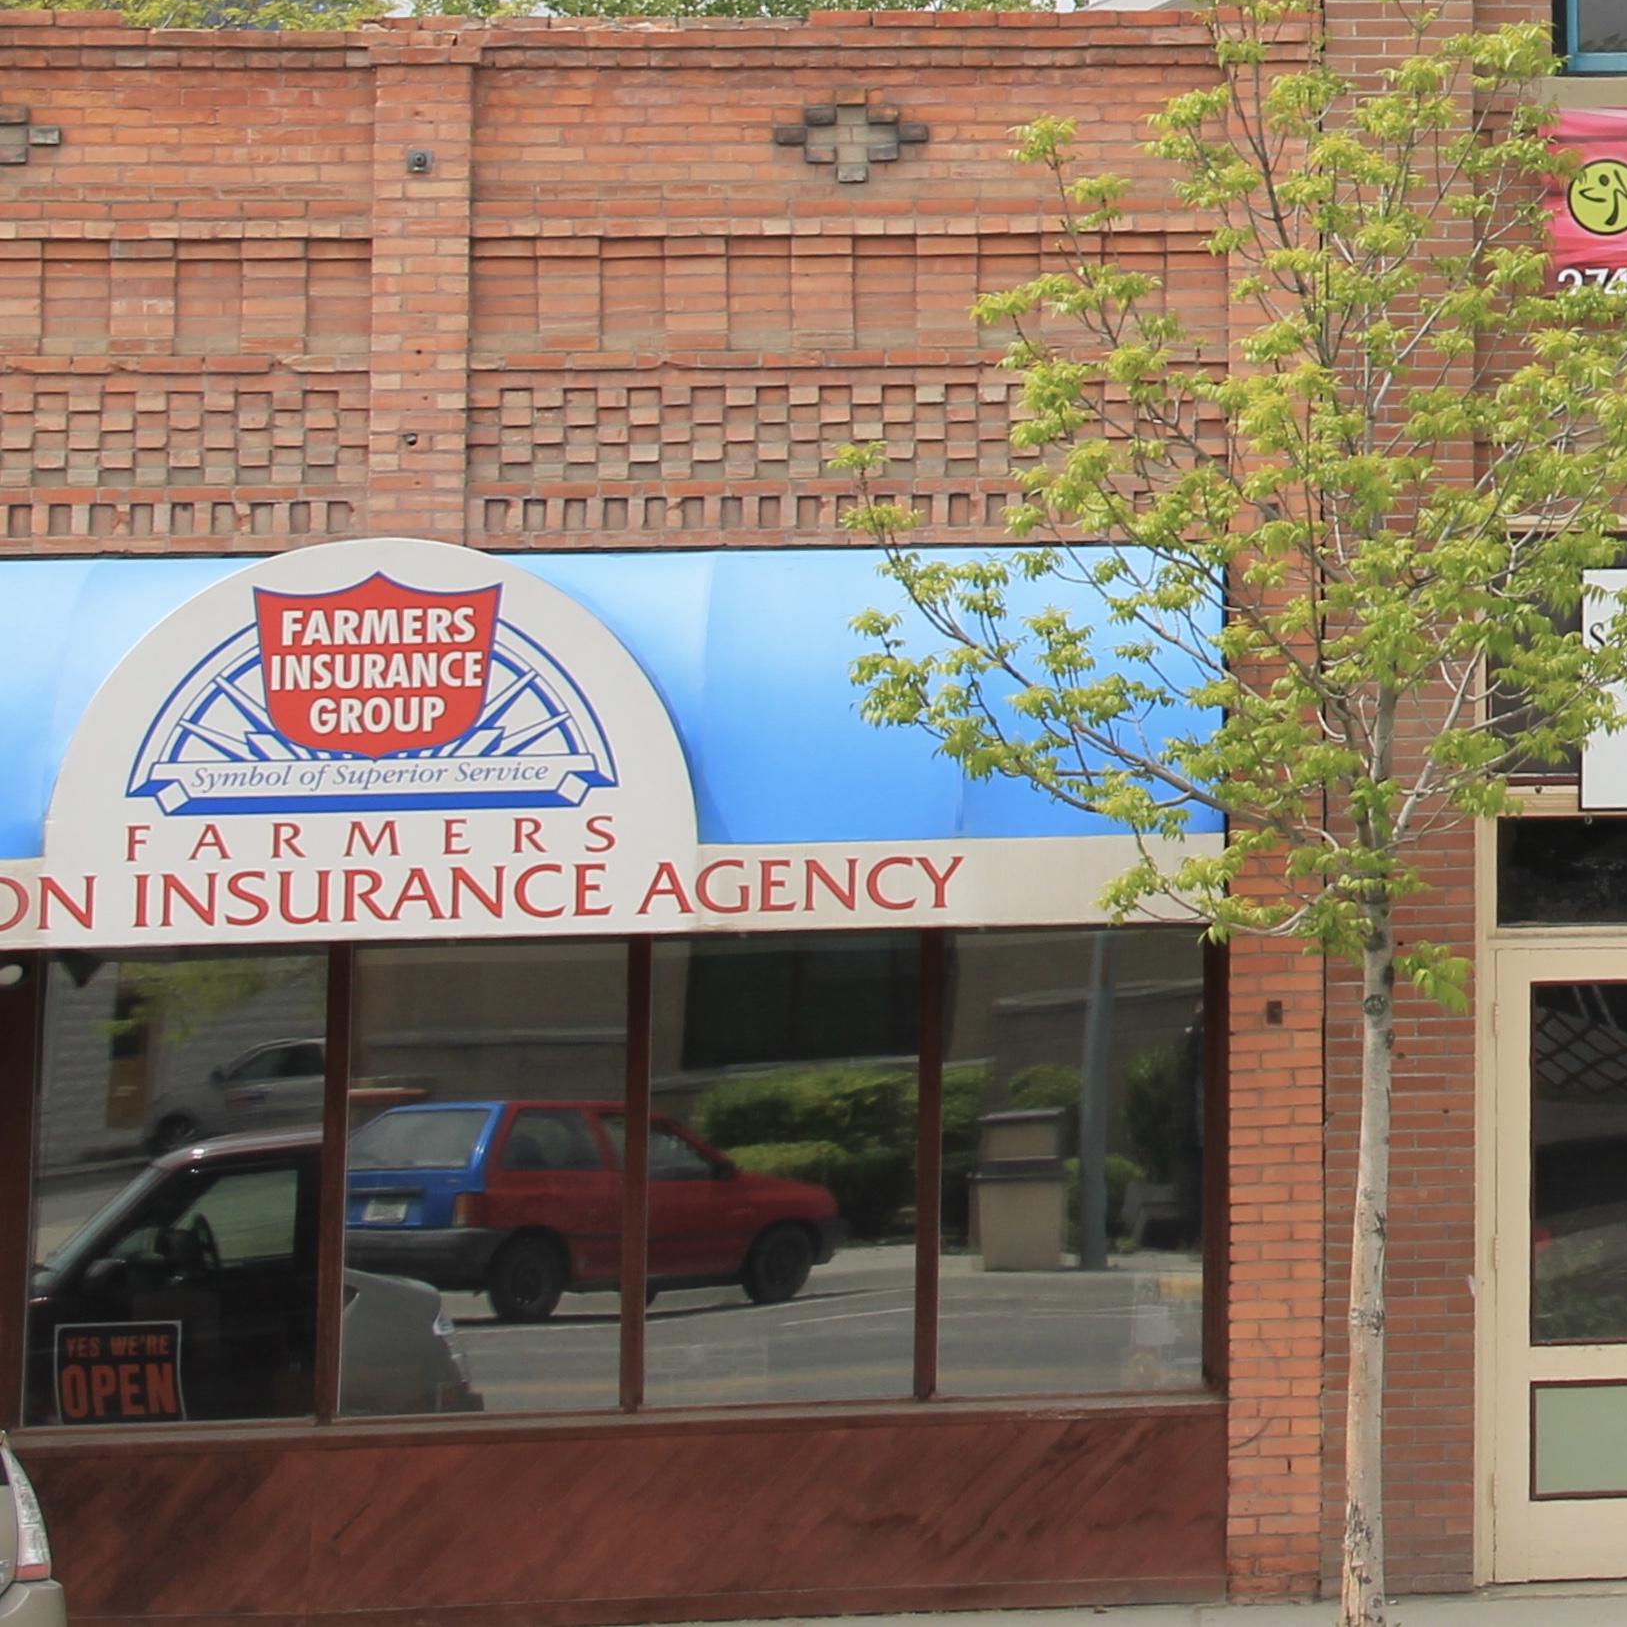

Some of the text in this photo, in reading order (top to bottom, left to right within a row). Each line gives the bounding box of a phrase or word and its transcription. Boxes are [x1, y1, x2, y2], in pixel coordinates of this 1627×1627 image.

[281, 607, 476, 645] FARMERS
[270, 652, 483, 691] INSURANCE
[309, 697, 446, 734] GROUP
[191, 761, 549, 793] Symbol of Superior Service
[125, 815, 617, 862] FARMERS
[132, 862, 613, 928] INSURANCE
[636, 856, 964, 915] AGENCY
[65, 1334, 170, 1358] YES WE'RE
[61, 1362, 177, 1419] OPEN
